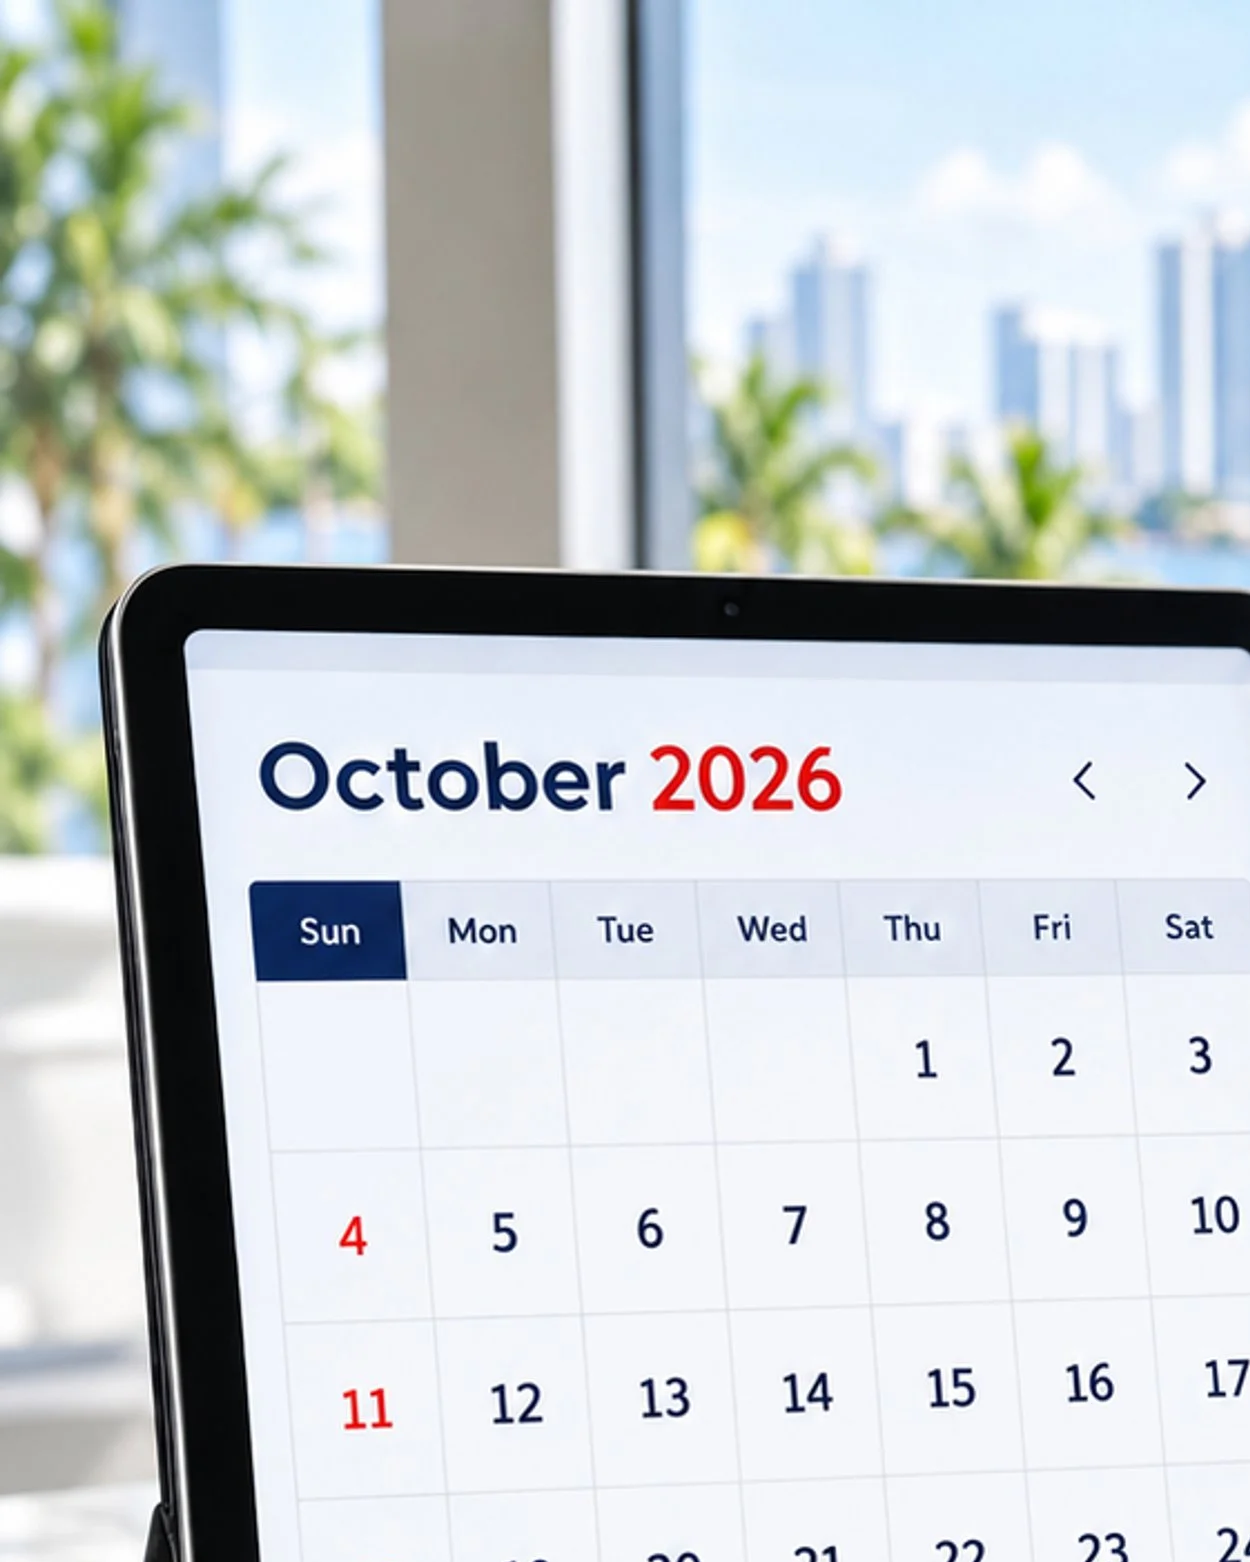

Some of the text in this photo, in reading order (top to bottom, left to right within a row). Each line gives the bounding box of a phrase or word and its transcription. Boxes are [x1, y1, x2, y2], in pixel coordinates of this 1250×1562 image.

[258, 740, 843, 813] October 2026
[300, 912, 1215, 946] Sun Mon Tue Wed Thu Fri Sat
[915, 1035, 1213, 1079] 1 2 3
[338, 1195, 1240, 1256] 4 5 6 7 8 9 10
[342, 1358, 1250, 1431] 11 12 13 14 15 16 17
